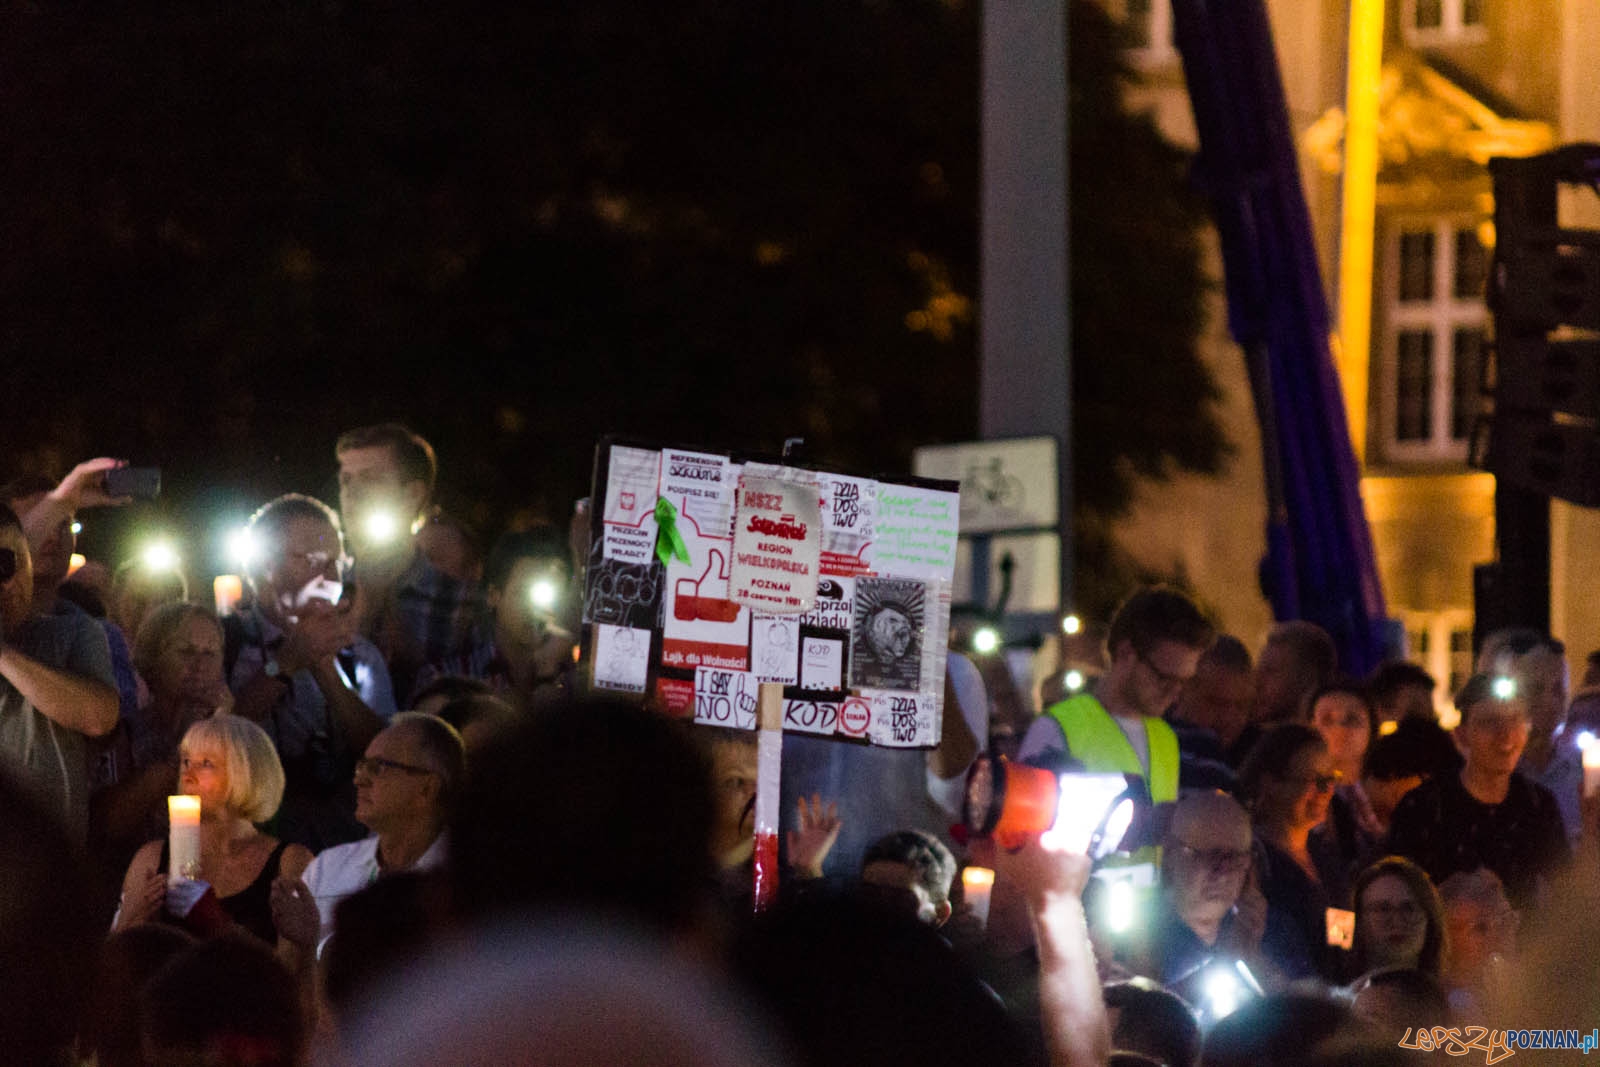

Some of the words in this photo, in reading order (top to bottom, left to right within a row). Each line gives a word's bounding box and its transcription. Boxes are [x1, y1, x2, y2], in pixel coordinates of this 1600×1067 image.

[671, 454, 723, 466] REFERENDUM
[667, 485, 702, 497] PODPISZ
[831, 481, 859, 499] DZIA
[744, 491, 783, 511] NSZZ
[832, 513, 858, 528] TWO
[612, 525, 649, 537] PRZECIW
[758, 543, 793, 555] REGION
[737, 552, 809, 575] WIELKOPOLSKA
[751, 579, 791, 592] POZNAŃ
[814, 598, 853, 614] eprzaj
[799, 611, 848, 628] dziadu
[663, 651, 684, 664] Lajk
[686, 652, 701, 664] dla
[698, 670, 710, 693] I
[710, 671, 733, 696] SAY
[696, 695, 731, 721] NO
[888, 696, 917, 713] DZIA
[784, 701, 837, 728] KOD
[892, 727, 917, 742] TWO
